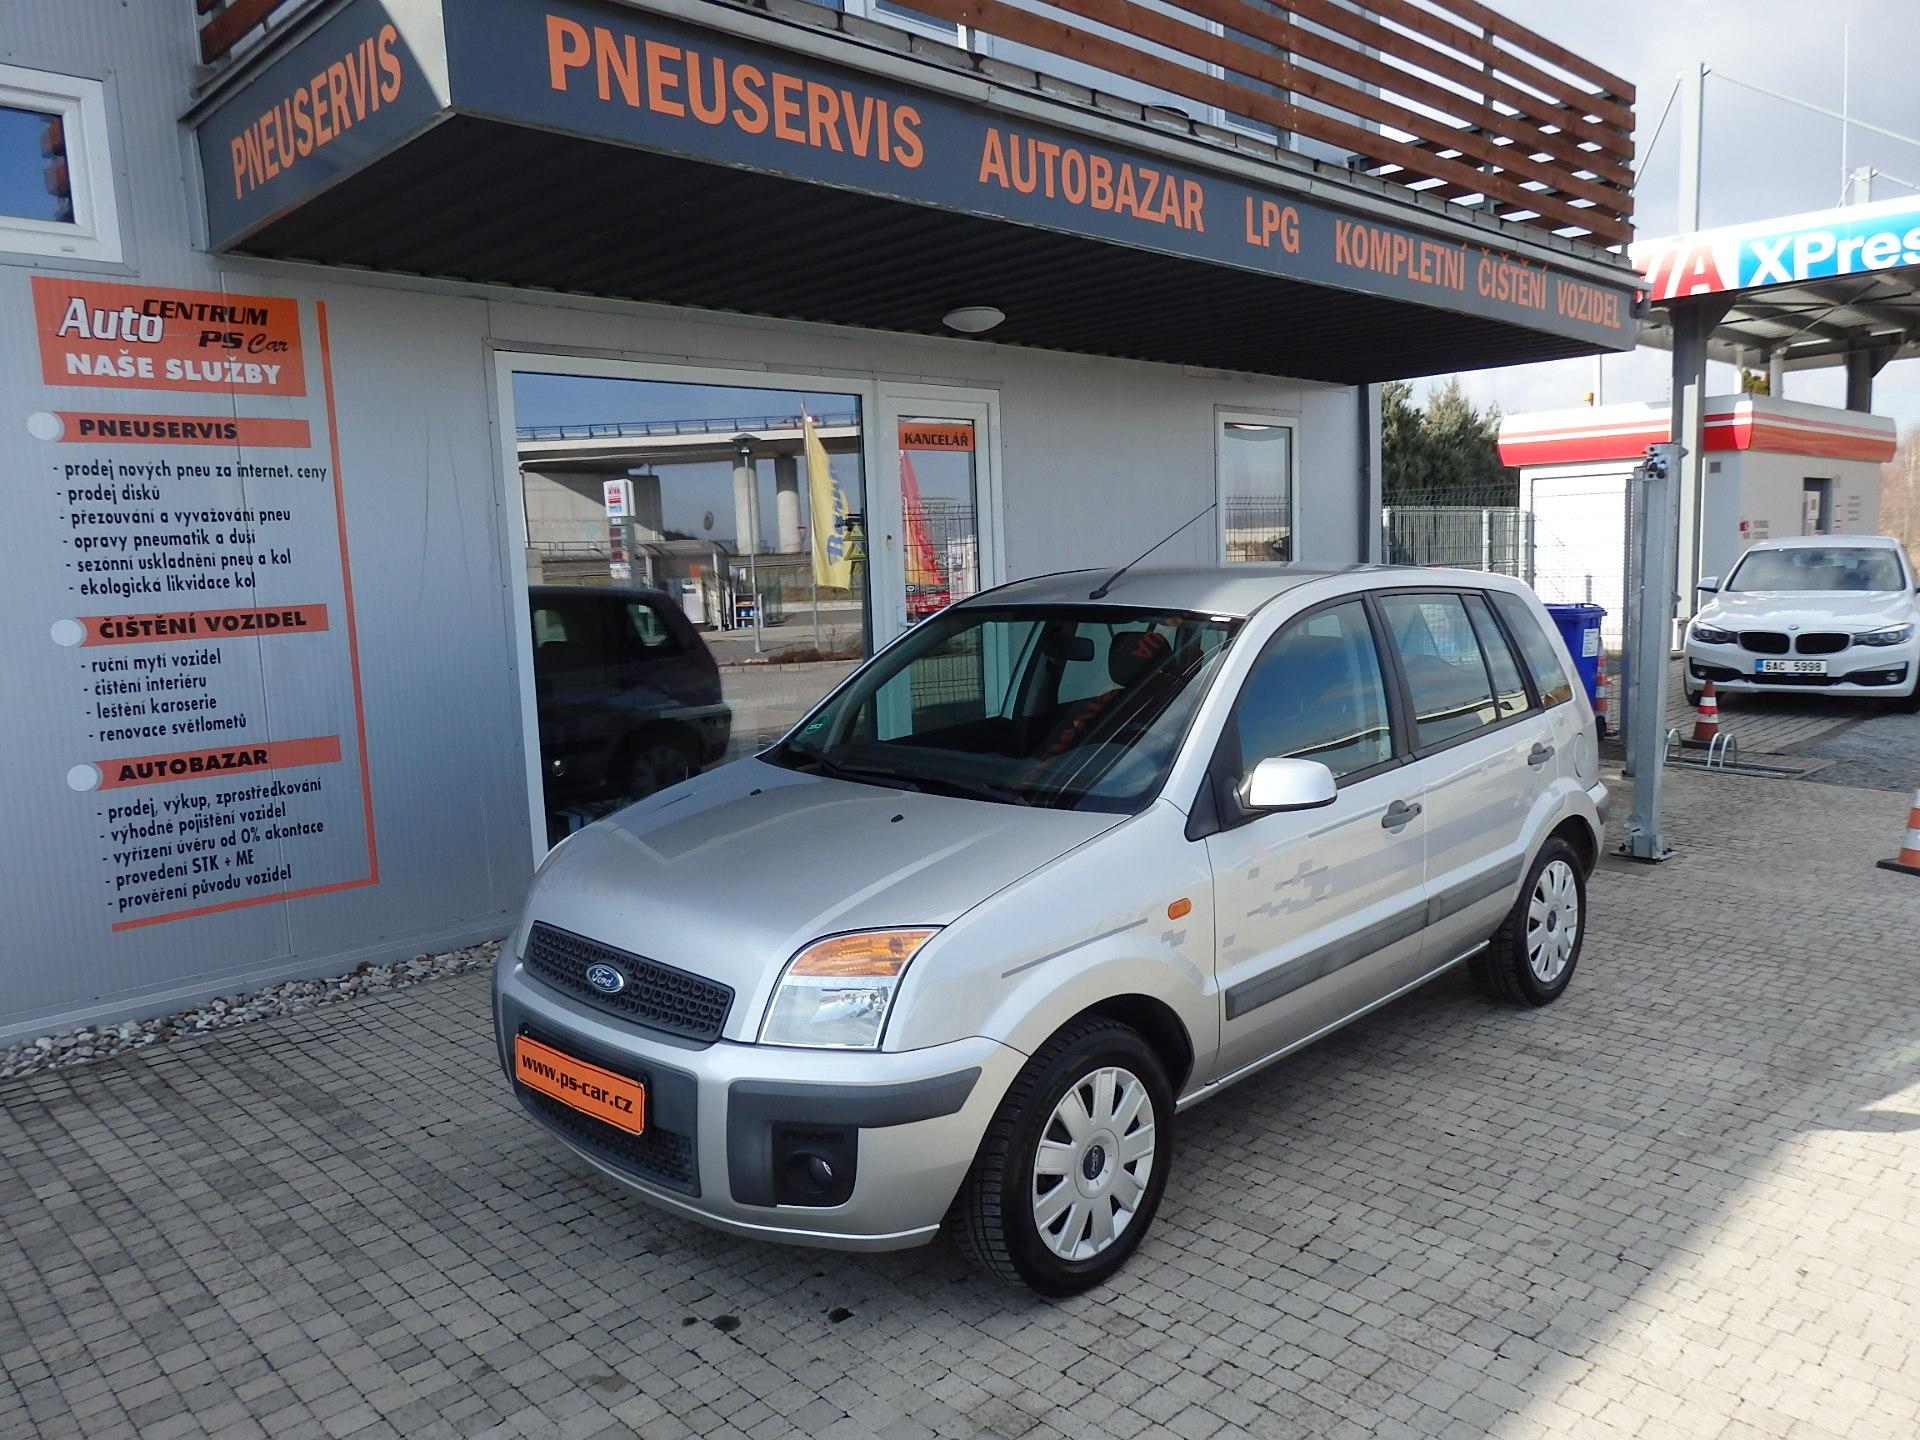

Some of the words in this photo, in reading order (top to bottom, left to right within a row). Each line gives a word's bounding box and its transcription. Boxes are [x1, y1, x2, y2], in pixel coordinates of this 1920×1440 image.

[230, 23, 401, 200] PNEUSERVIS
[545, 13, 925, 169] PNEUSERVIS
[978, 127, 1205, 233] AUTOBAZAR
[1245, 196, 1299, 254] LPG
[1335, 218, 1467, 291] KOMPLETNÍ
[1477, 246, 1548, 310] ČIŠTĚNÍ
[1557, 279, 1621, 328] VOZIDEL
[57, 296, 165, 343] Auto
[143, 299, 268, 326] CENTRUM
[198, 330, 244, 349] PS
[247, 333, 288, 355] Car
[65, 348, 154, 379] NAŠE
[166, 355, 281, 385] SLUŽBY
[79, 418, 238, 440] PNEUSERVIS
[904, 431, 968, 447] KANCELÁŘ
[65, 460, 114, 480] prodej
[119, 461, 171, 480] nových
[177, 465, 210, 480] pneu
[216, 467, 232, 478] za
[237, 463, 293, 478] internet.
[298, 467, 327, 482] ceny
[68, 484, 117, 505] prodej
[71, 509, 154, 528] přezouvání
[160, 513, 169, 523] a
[174, 507, 255, 527] vyvažování
[259, 510, 291, 525] pneu
[74, 535, 127, 552] opravy
[133, 529, 210, 550] pneumatik
[215, 534, 224, 545] a
[229, 528, 255, 544] duší
[77, 555, 133, 572] sezónní
[138, 552, 216, 570] uskladnění
[221, 554, 253, 570] pneu
[258, 555, 267, 565] a
[271, 548, 292, 565] kol
[80, 576, 161, 598] ekologická
[166, 573, 230, 592] likvidace
[235, 572, 255, 588] kol
[99, 613, 197, 639] ČIŠTĚNÍ
[204, 611, 307, 632] VOZIDEL
[92, 655, 128, 673] ruční
[133, 653, 167, 674] mytí
[171, 648, 221, 666] vozidel
[1765, 661, 1785, 671] 6AC
[95, 678, 141, 696] čištění
[146, 675, 206, 692] interiéru
[97, 700, 145, 719] leštění
[151, 694, 217, 714] karoserie
[99, 722, 166, 742] renovace
[172, 713, 247, 735] světlometů
[118, 749, 268, 782] AUTOBAZAR
[108, 798, 158, 823] prodej,
[164, 793, 211, 814] výkup,
[216, 777, 321, 805] zprostředkování
[111, 819, 173, 844] výhodné
[179, 811, 235, 837] pojištění
[239, 801, 286, 823] vozidel
[176, 834, 215, 855] úvěru
[220, 830, 236, 847] od
[241, 826, 261, 844] 0%
[265, 821, 324, 840] akontace
[116, 861, 187, 890] provedení
[192, 855, 219, 874] STK
[224, 857, 231, 867] +
[236, 849, 254, 867] ME
[118, 883, 187, 913] prověření
[192, 873, 241, 900] původu
[245, 864, 292, 886] vozidel
[592, 968, 614, 987] Ford
[521, 1053, 633, 1115] www.ps-car.cz
